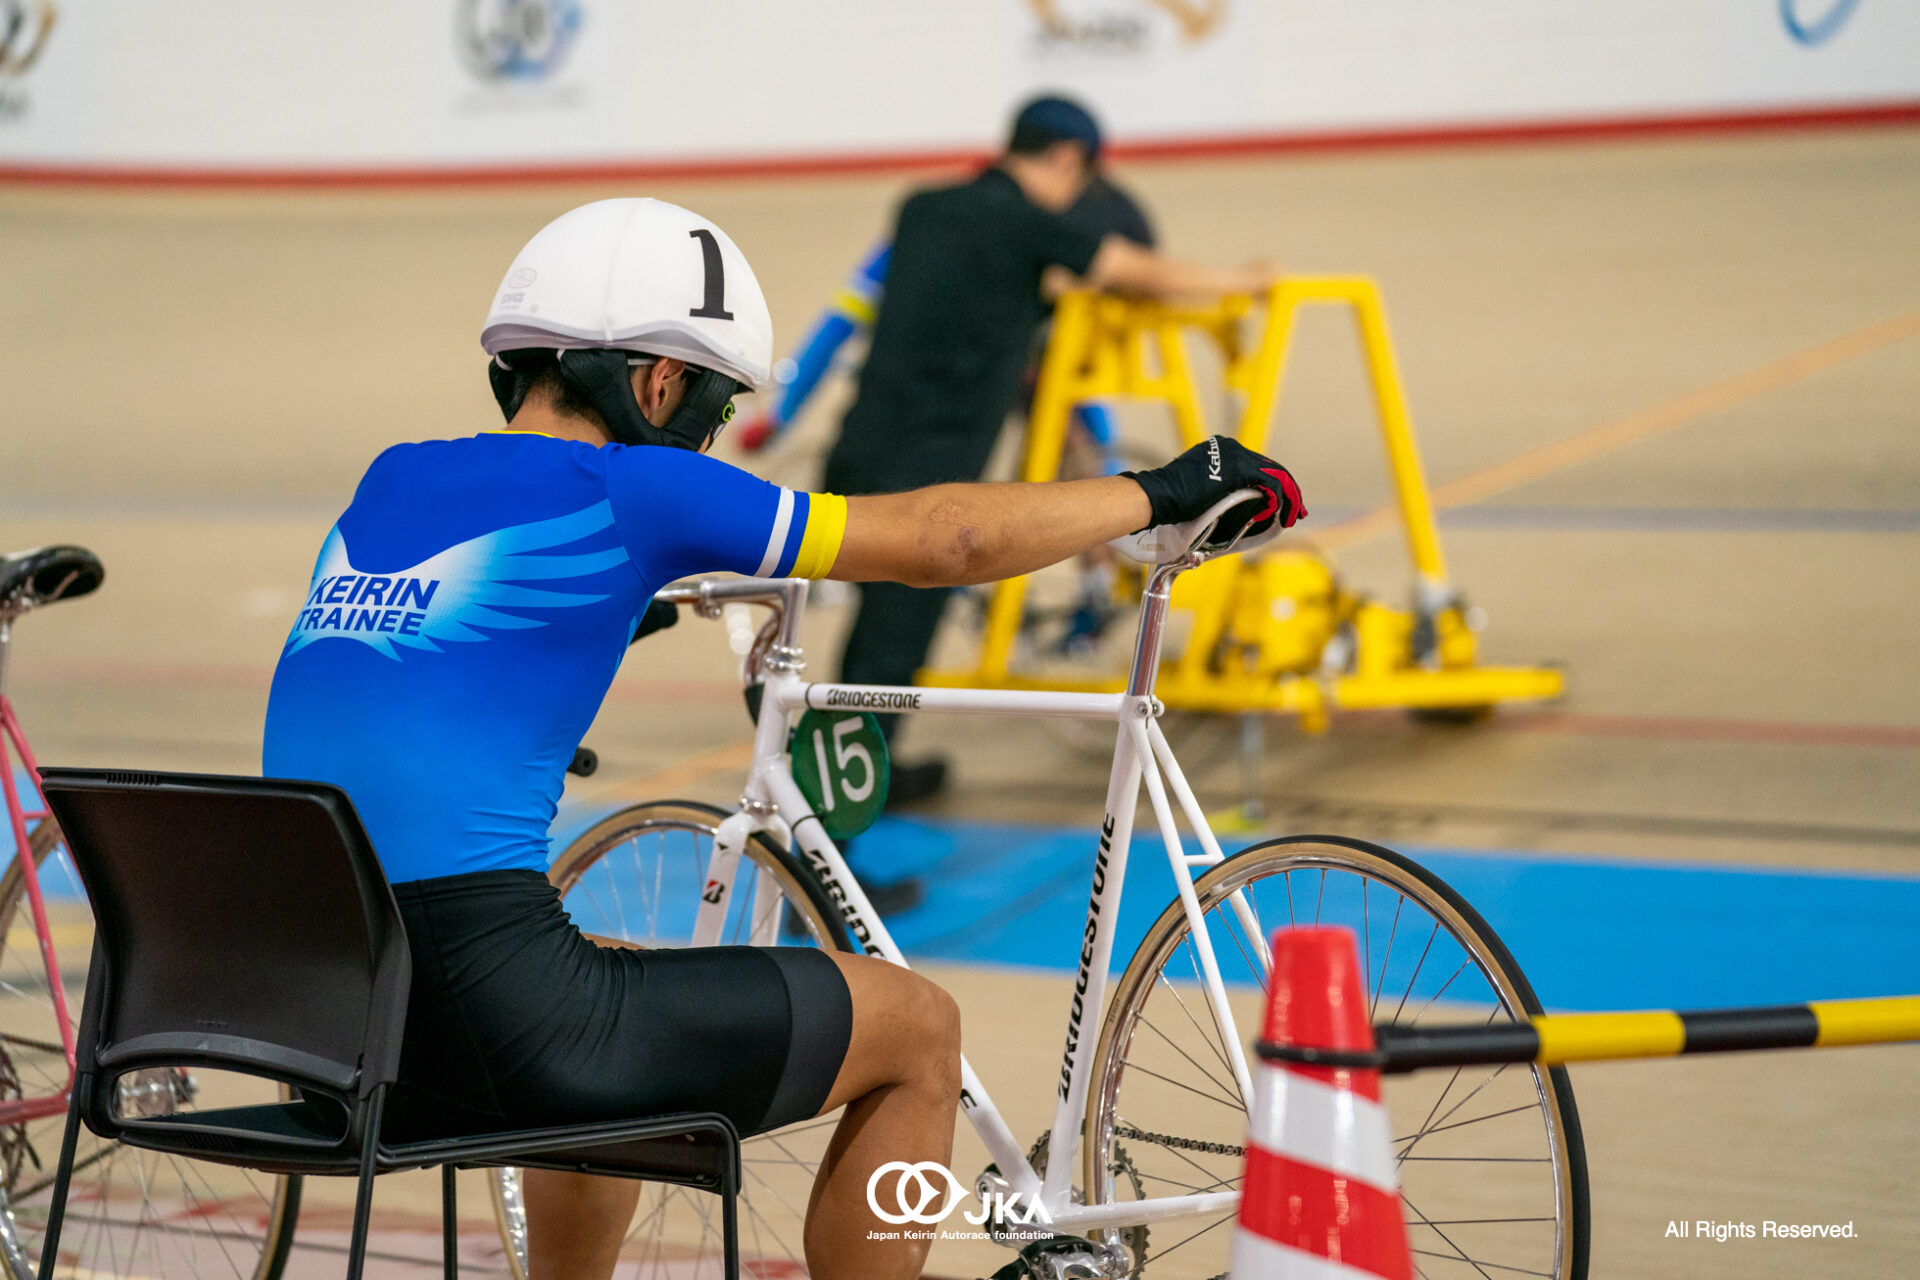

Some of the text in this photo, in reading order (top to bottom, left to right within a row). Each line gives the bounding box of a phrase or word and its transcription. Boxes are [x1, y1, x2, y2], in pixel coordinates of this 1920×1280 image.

[688, 229, 735, 321] 1
[306, 575, 440, 610] KEIRIN
[296, 607, 426, 636] TRAINEE
[826, 688, 922, 709] BRIDGESTONE
[813, 716, 875, 812] 15
